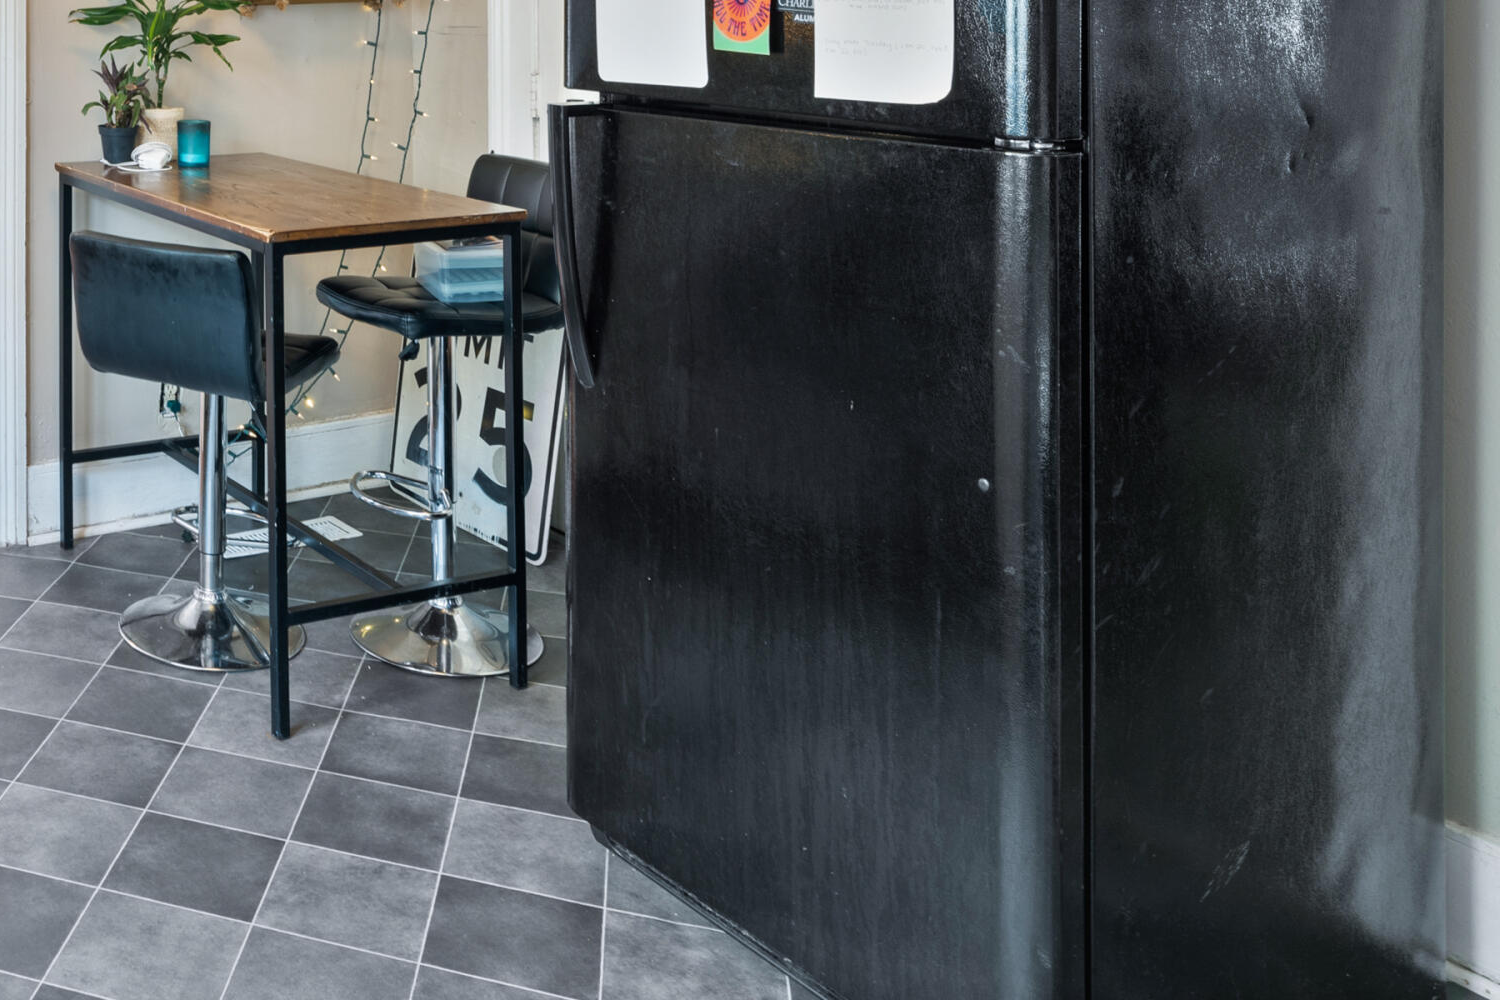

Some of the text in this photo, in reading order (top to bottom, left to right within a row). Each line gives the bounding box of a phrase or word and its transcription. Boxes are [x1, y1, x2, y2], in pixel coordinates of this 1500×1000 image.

[714, 0, 771, 36] ALL THE TIME
